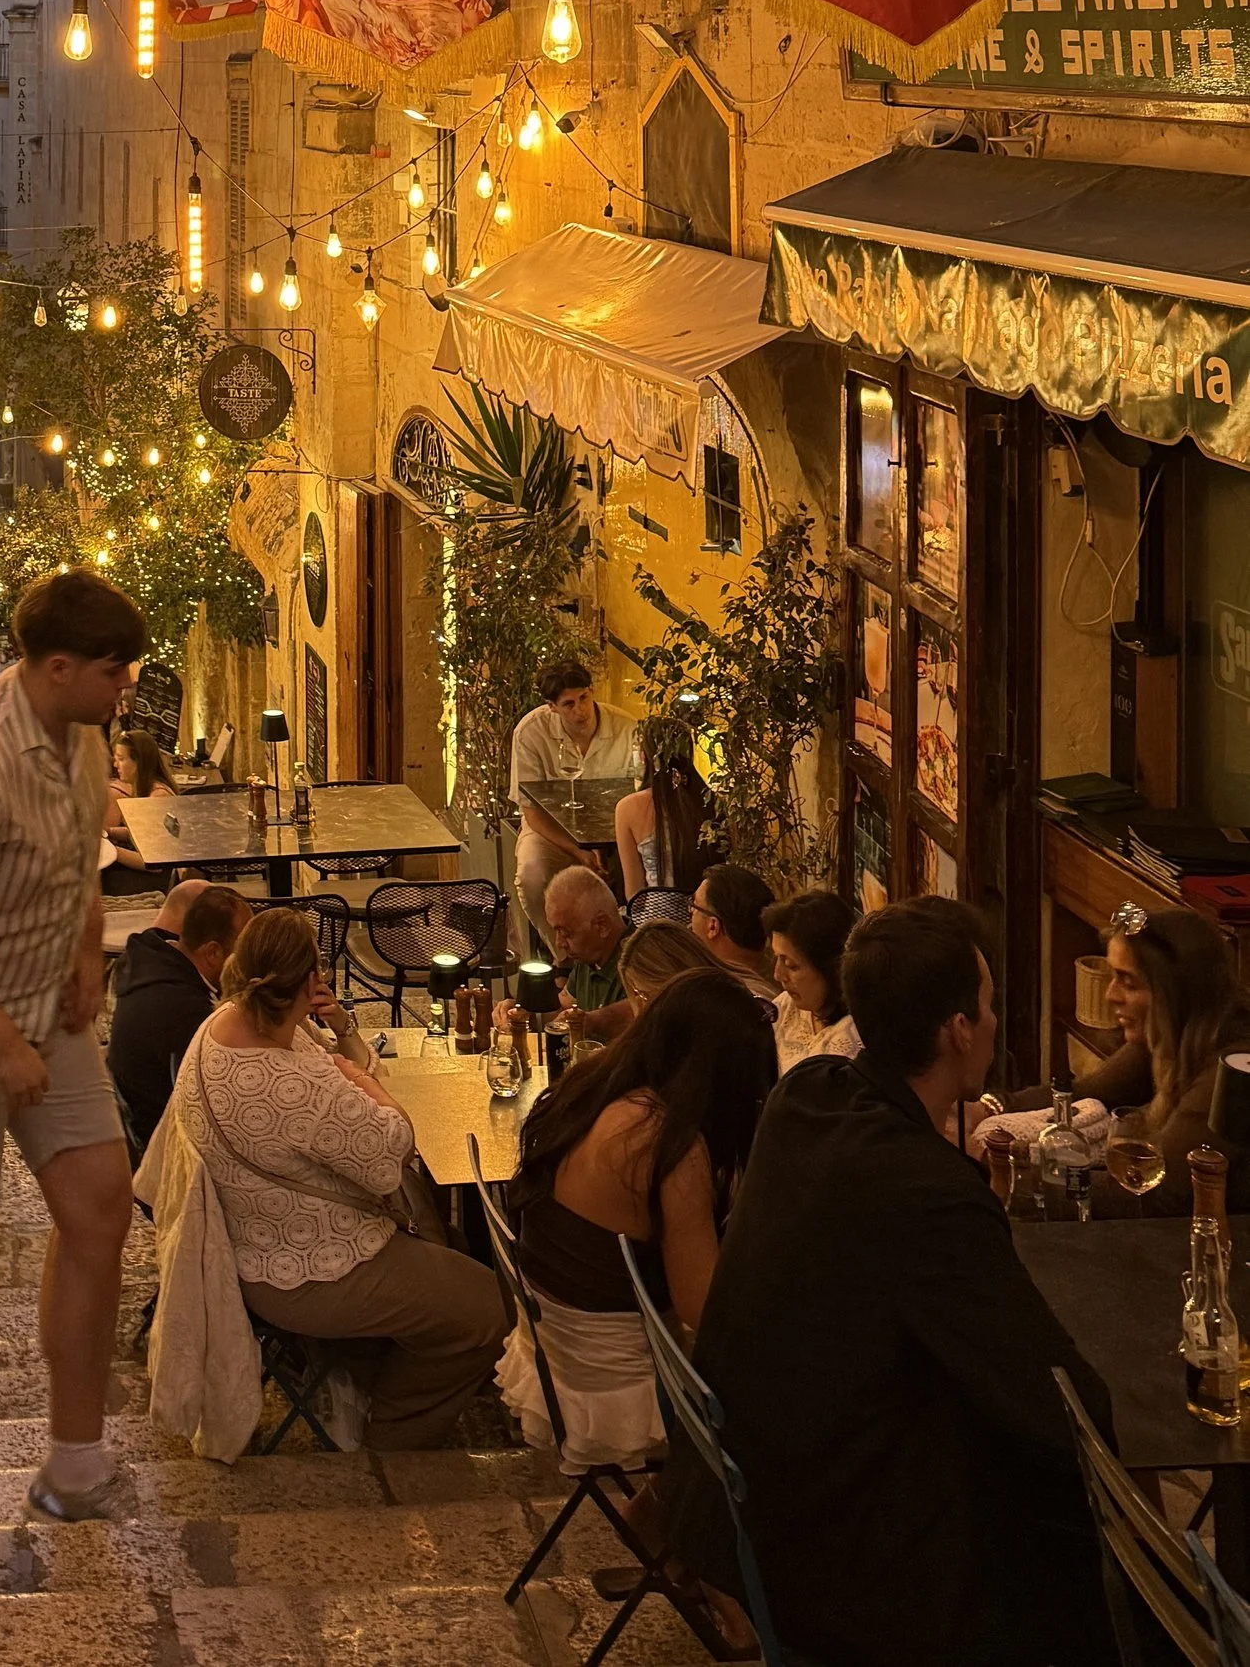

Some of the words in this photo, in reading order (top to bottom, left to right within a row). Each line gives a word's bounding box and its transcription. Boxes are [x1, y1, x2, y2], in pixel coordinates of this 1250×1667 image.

[1023, 29, 1045, 74] &
[1060, 29, 1235, 79] SPIRITS
[17, 77, 26, 122] CASA
[17, 136, 26, 204] LAPIRA
[228, 388, 262, 398] TASTE
